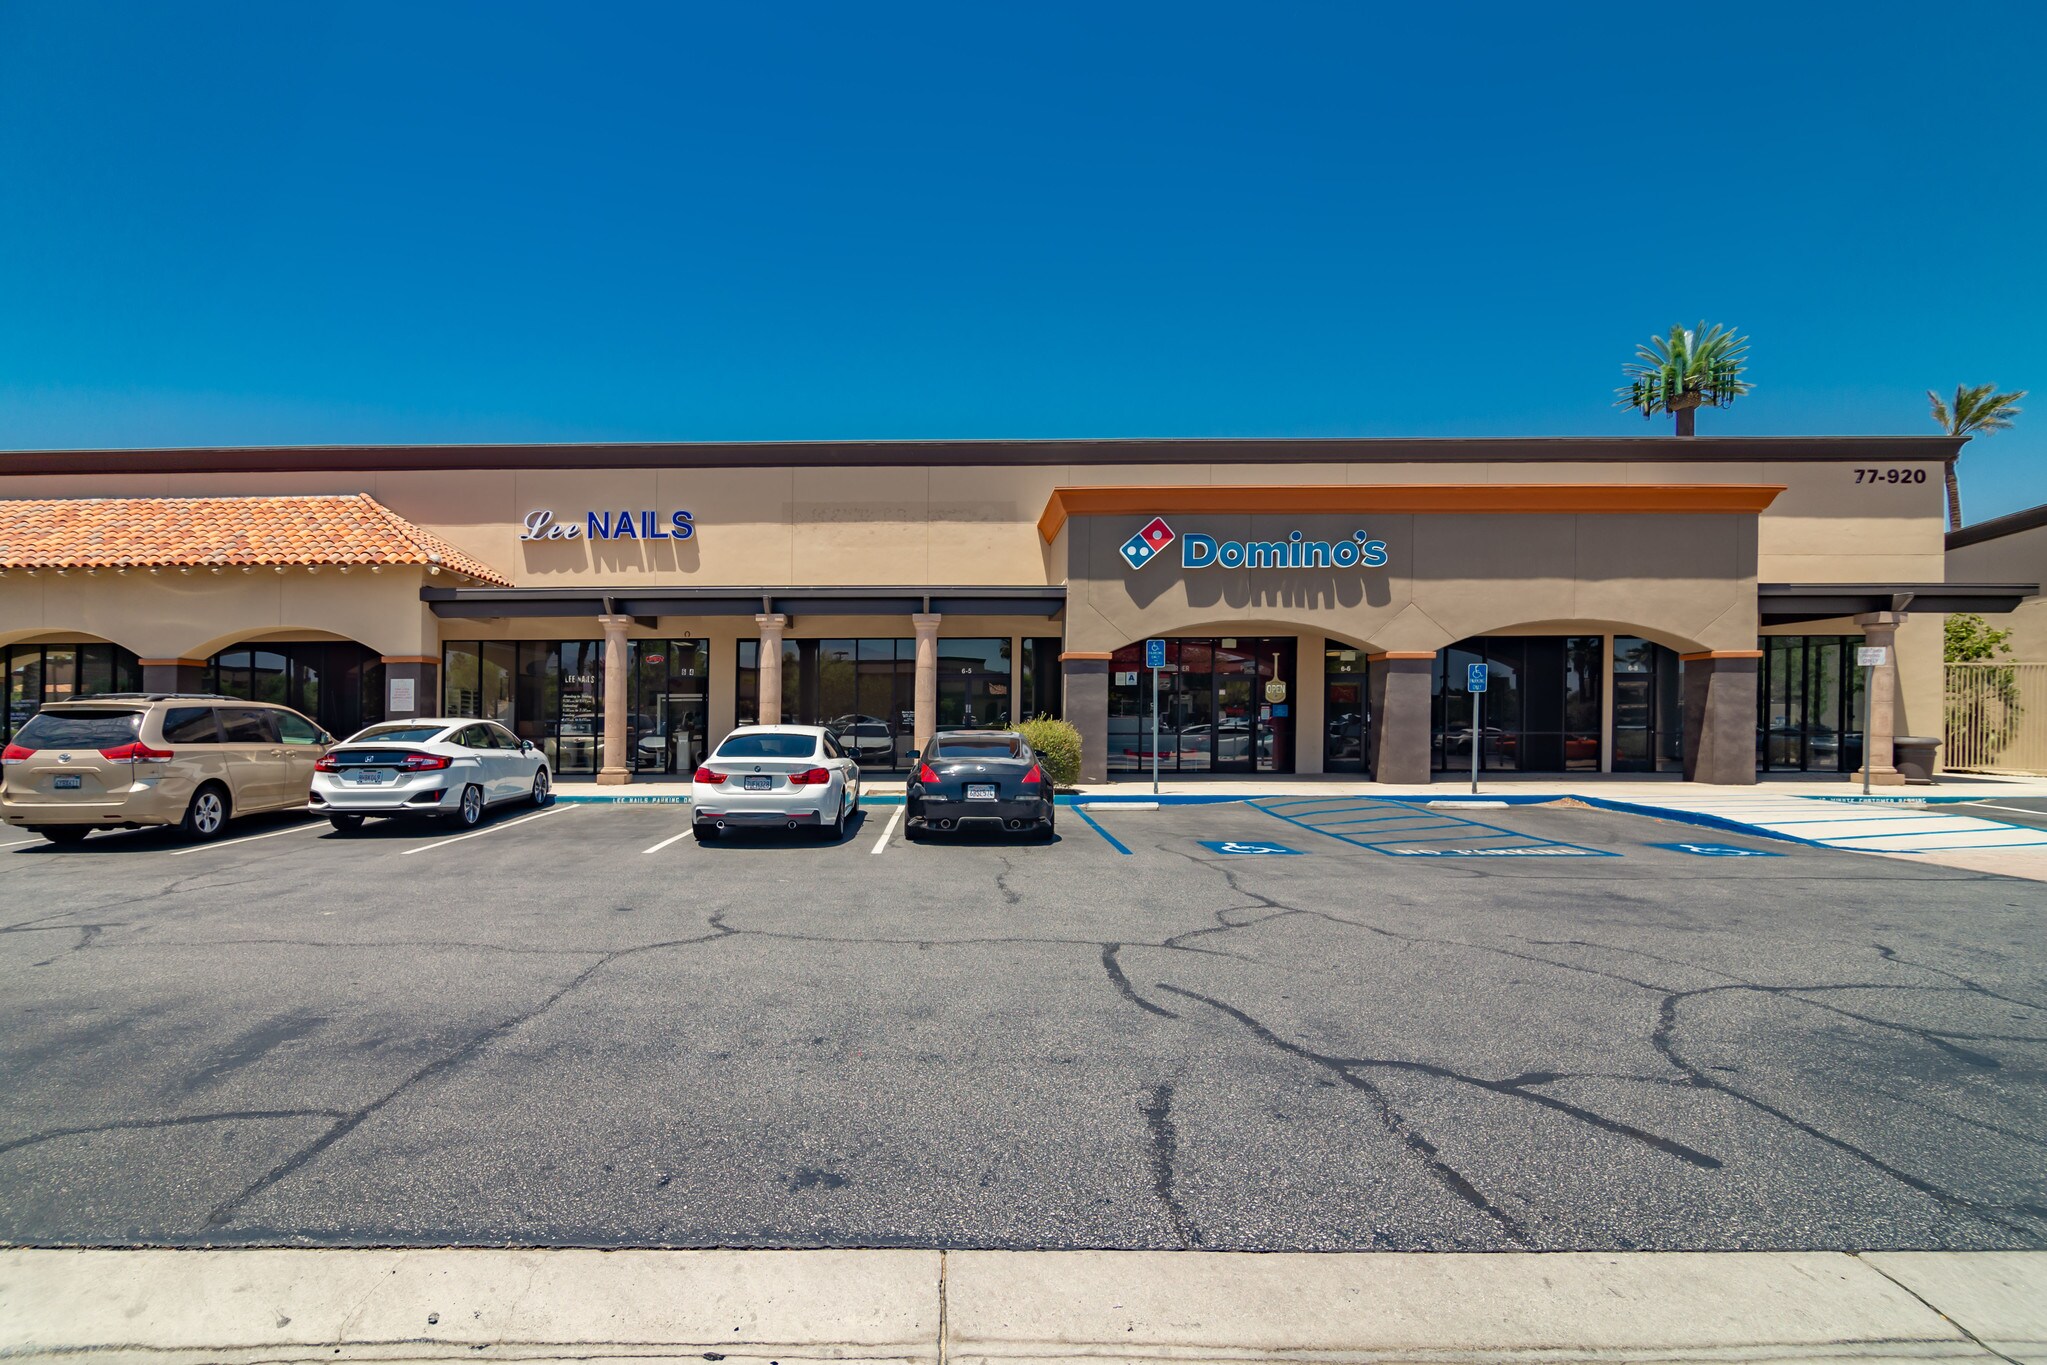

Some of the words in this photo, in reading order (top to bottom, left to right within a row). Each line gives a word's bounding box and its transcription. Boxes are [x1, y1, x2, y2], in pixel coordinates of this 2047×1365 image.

[1854, 469, 1926, 484] 77-920
[519, 510, 581, 541] Lee
[587, 510, 694, 540] NAILS
[1181, 529, 1389, 569] Domino's
[1266, 684, 1286, 694] OPEN
